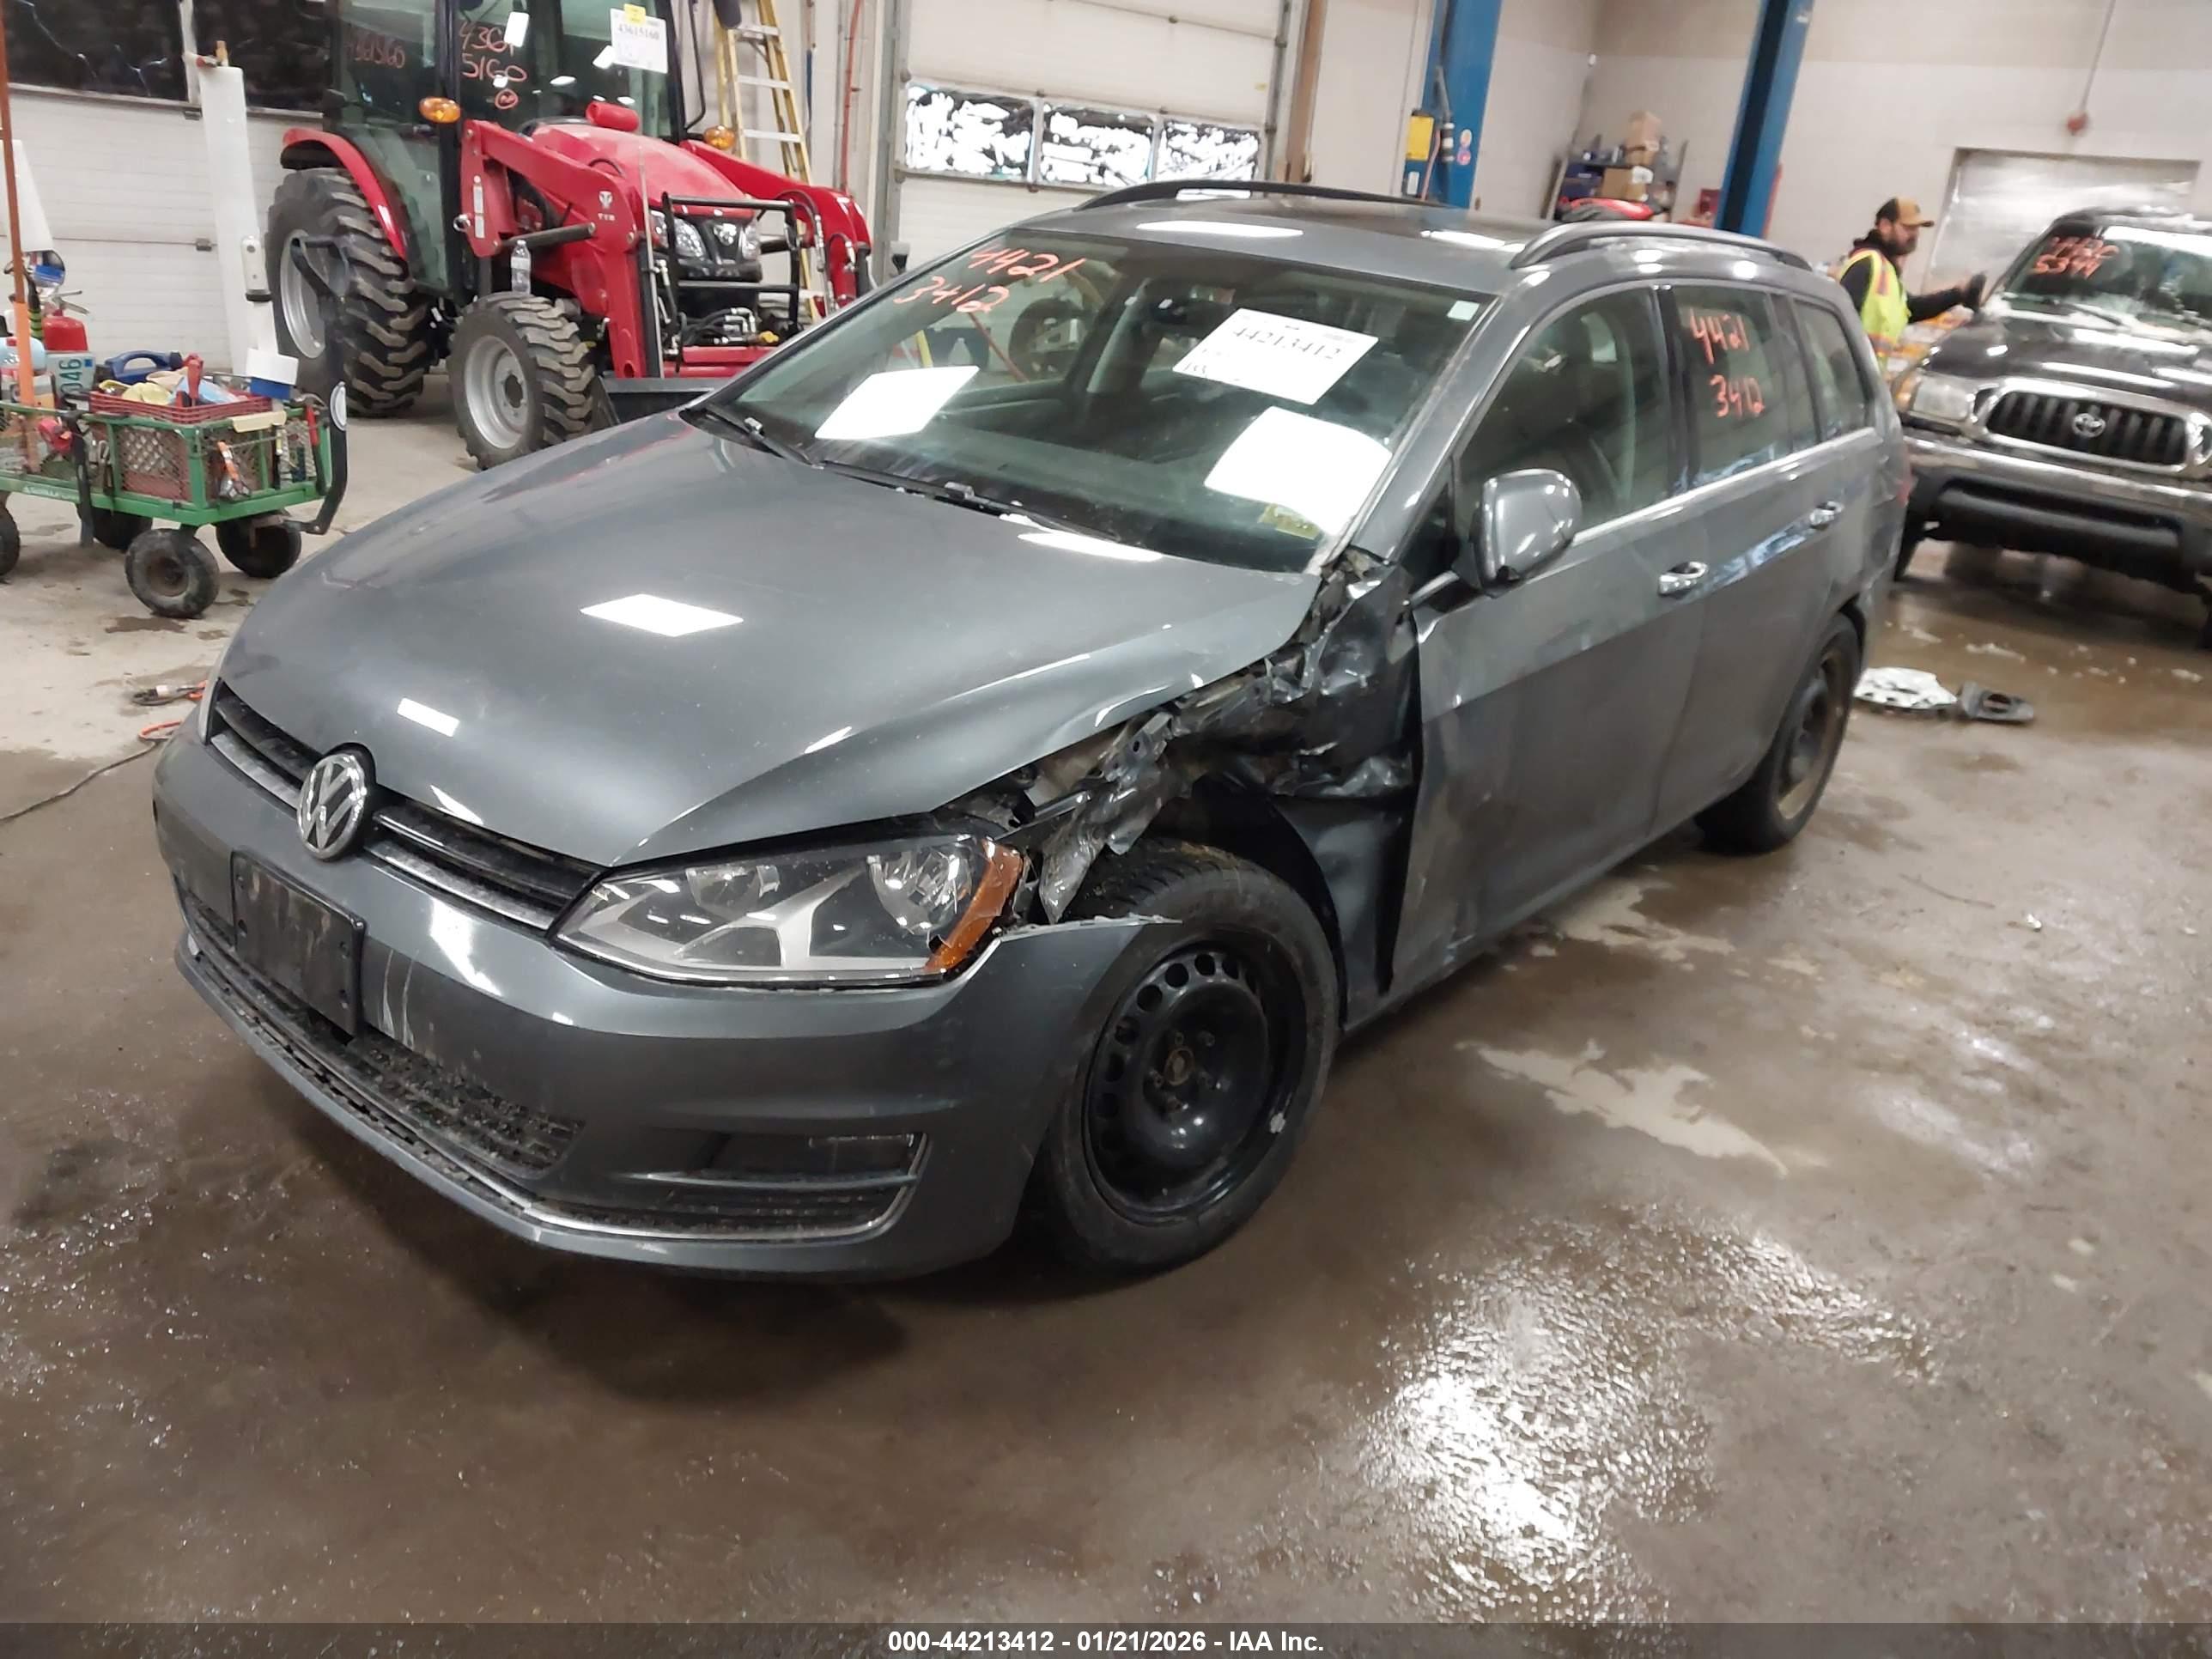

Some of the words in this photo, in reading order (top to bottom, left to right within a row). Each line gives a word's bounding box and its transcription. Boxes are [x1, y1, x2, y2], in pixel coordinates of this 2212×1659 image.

[968, 246, 1086, 283] 4421
[893, 276, 1011, 313] 3412
[1232, 327, 1343, 361] 44213412
[1688, 309, 1750, 365] 4421
[1709, 374, 1766, 418] 3412
